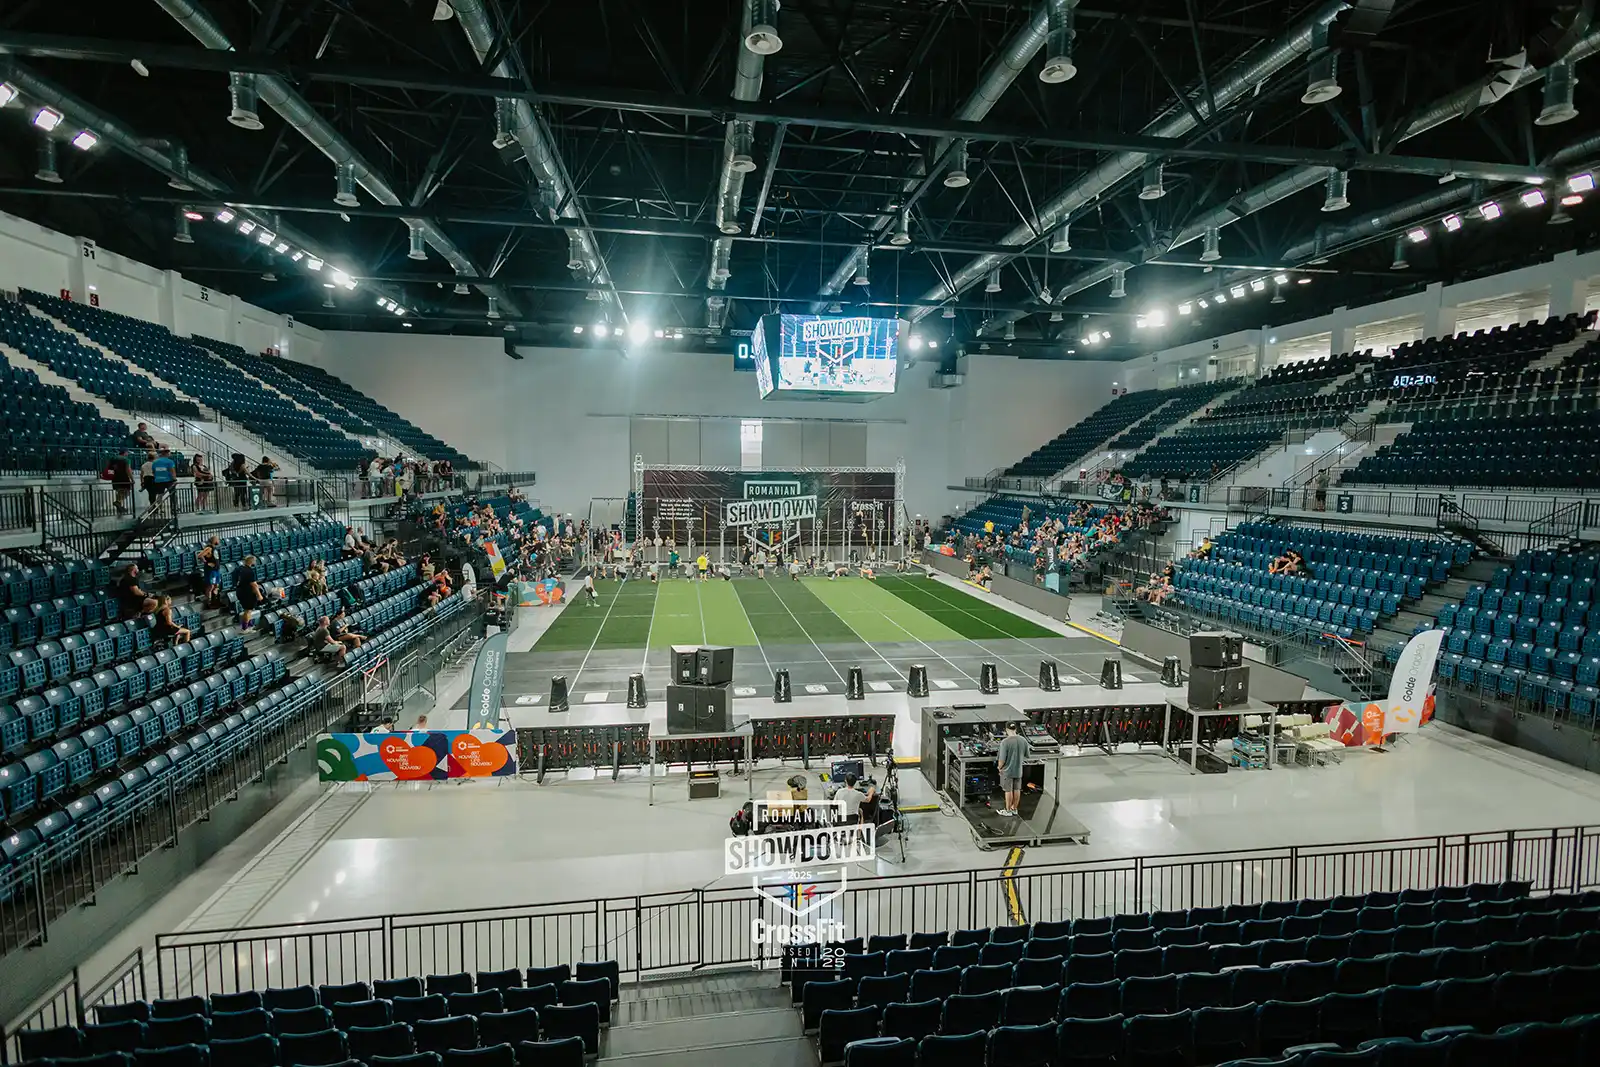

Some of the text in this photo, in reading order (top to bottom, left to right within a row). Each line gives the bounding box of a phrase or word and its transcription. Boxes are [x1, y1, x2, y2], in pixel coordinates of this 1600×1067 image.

[83, 247, 95, 260] 31
[200, 292, 208, 302] 32
[805, 319, 870, 338] SHOWDOWN
[748, 486, 796, 496] ROMANIAN
[253, 494, 259, 506] 9
[851, 501, 884, 510] CrossFit
[1341, 501, 1348, 511] 3
[729, 498, 814, 523] SHOWDOWN
[480, 650, 494, 716] Golde Oradea
[1402, 676, 1416, 702] Golde
